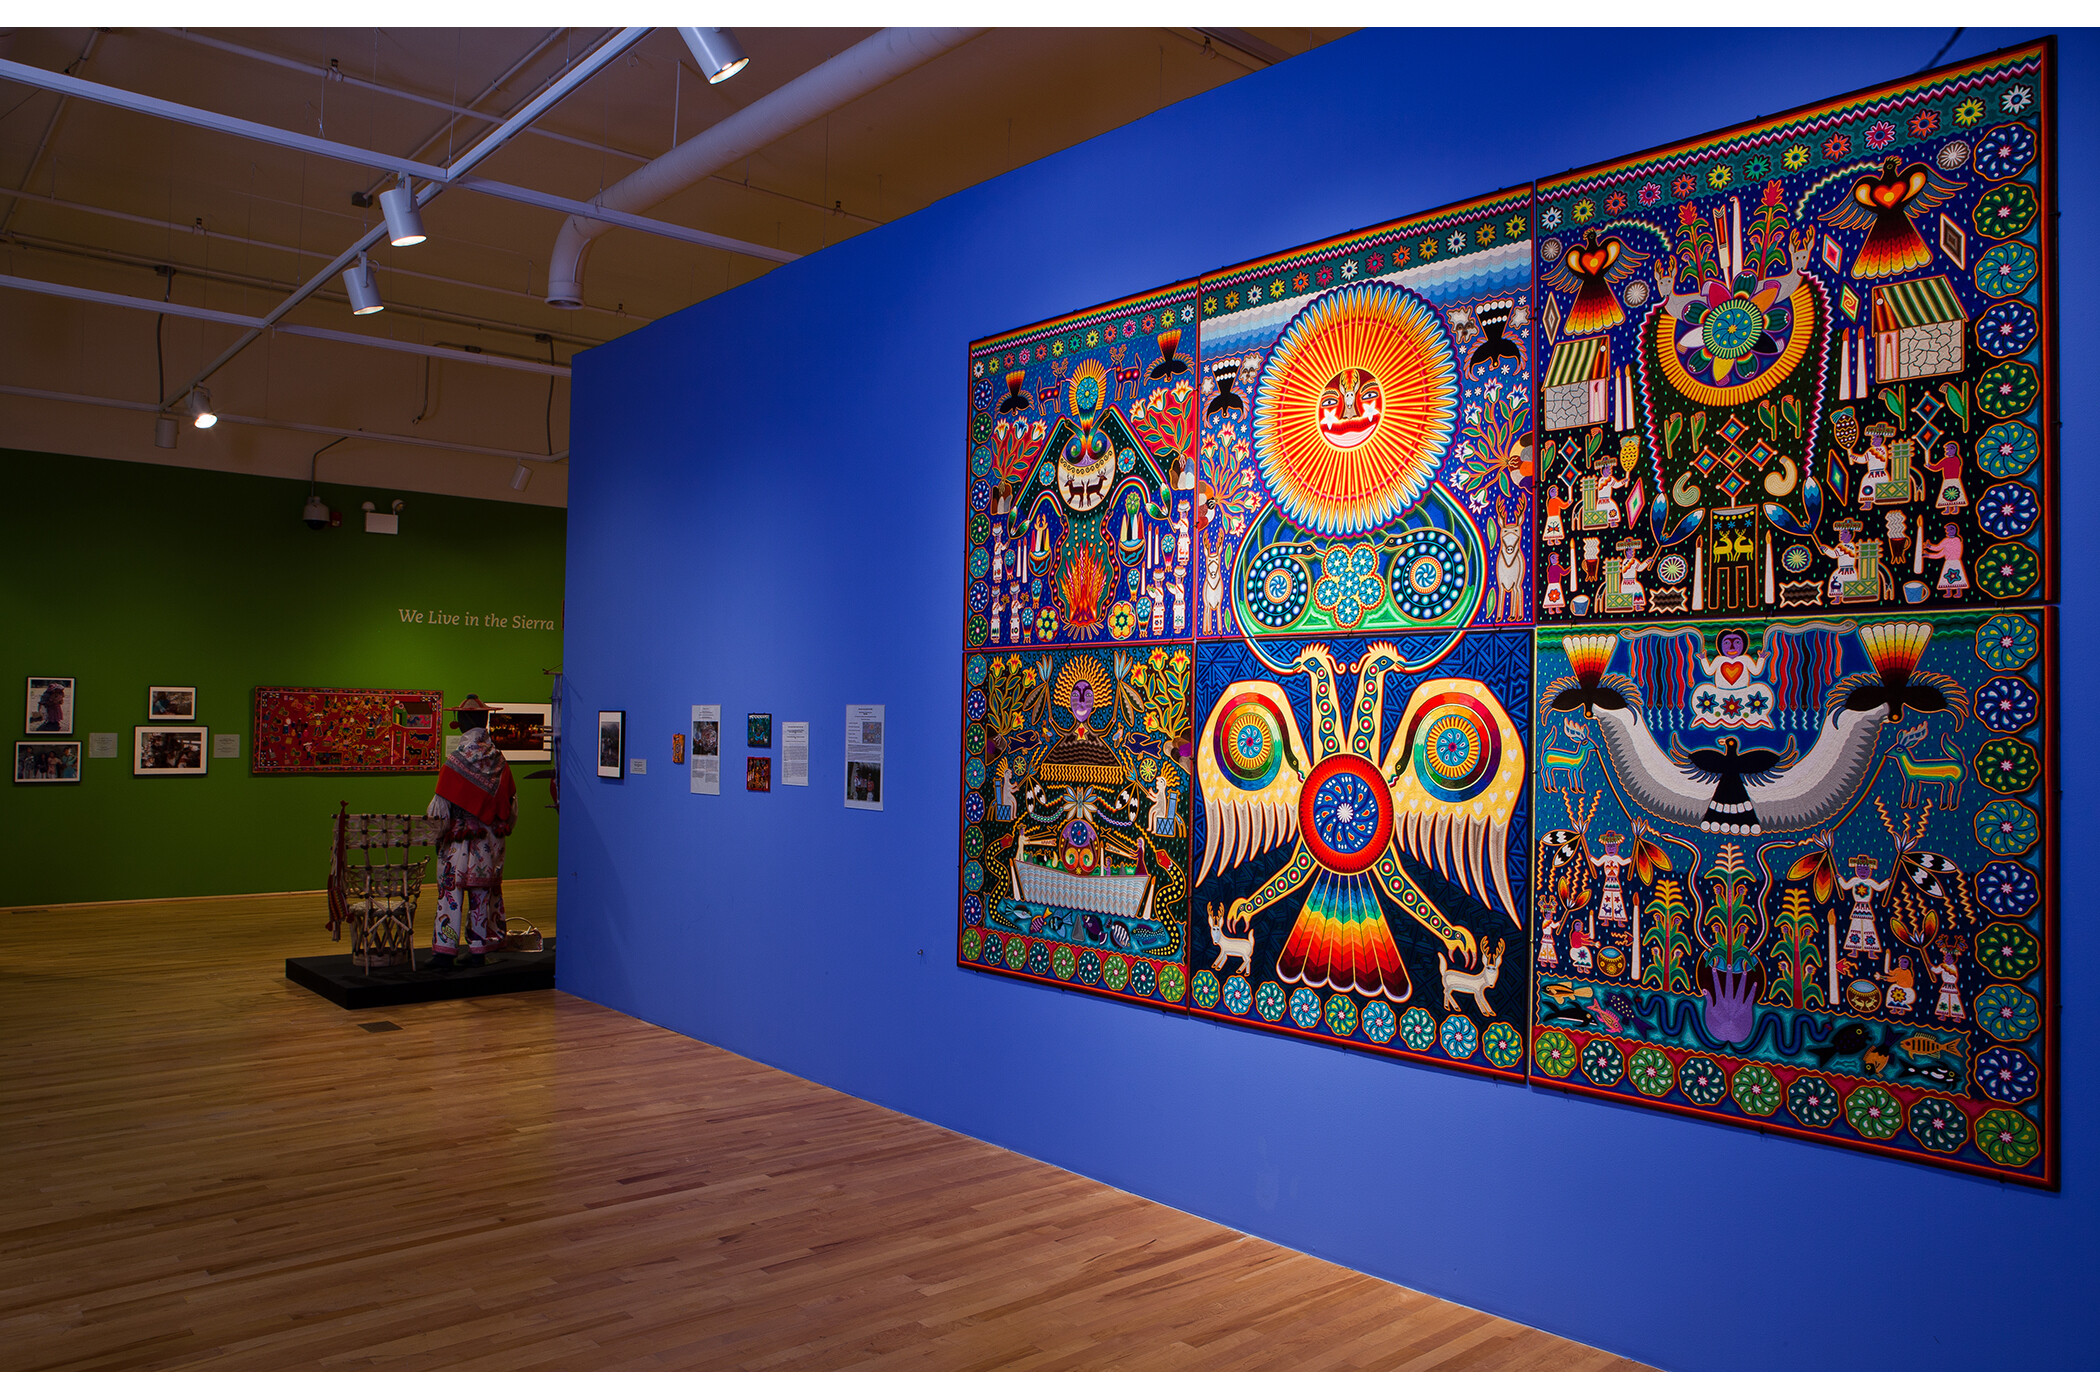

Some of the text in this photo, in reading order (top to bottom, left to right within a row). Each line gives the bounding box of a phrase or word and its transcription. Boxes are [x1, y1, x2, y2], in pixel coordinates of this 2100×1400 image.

[398, 608, 555, 631] We Live in the Sierra
